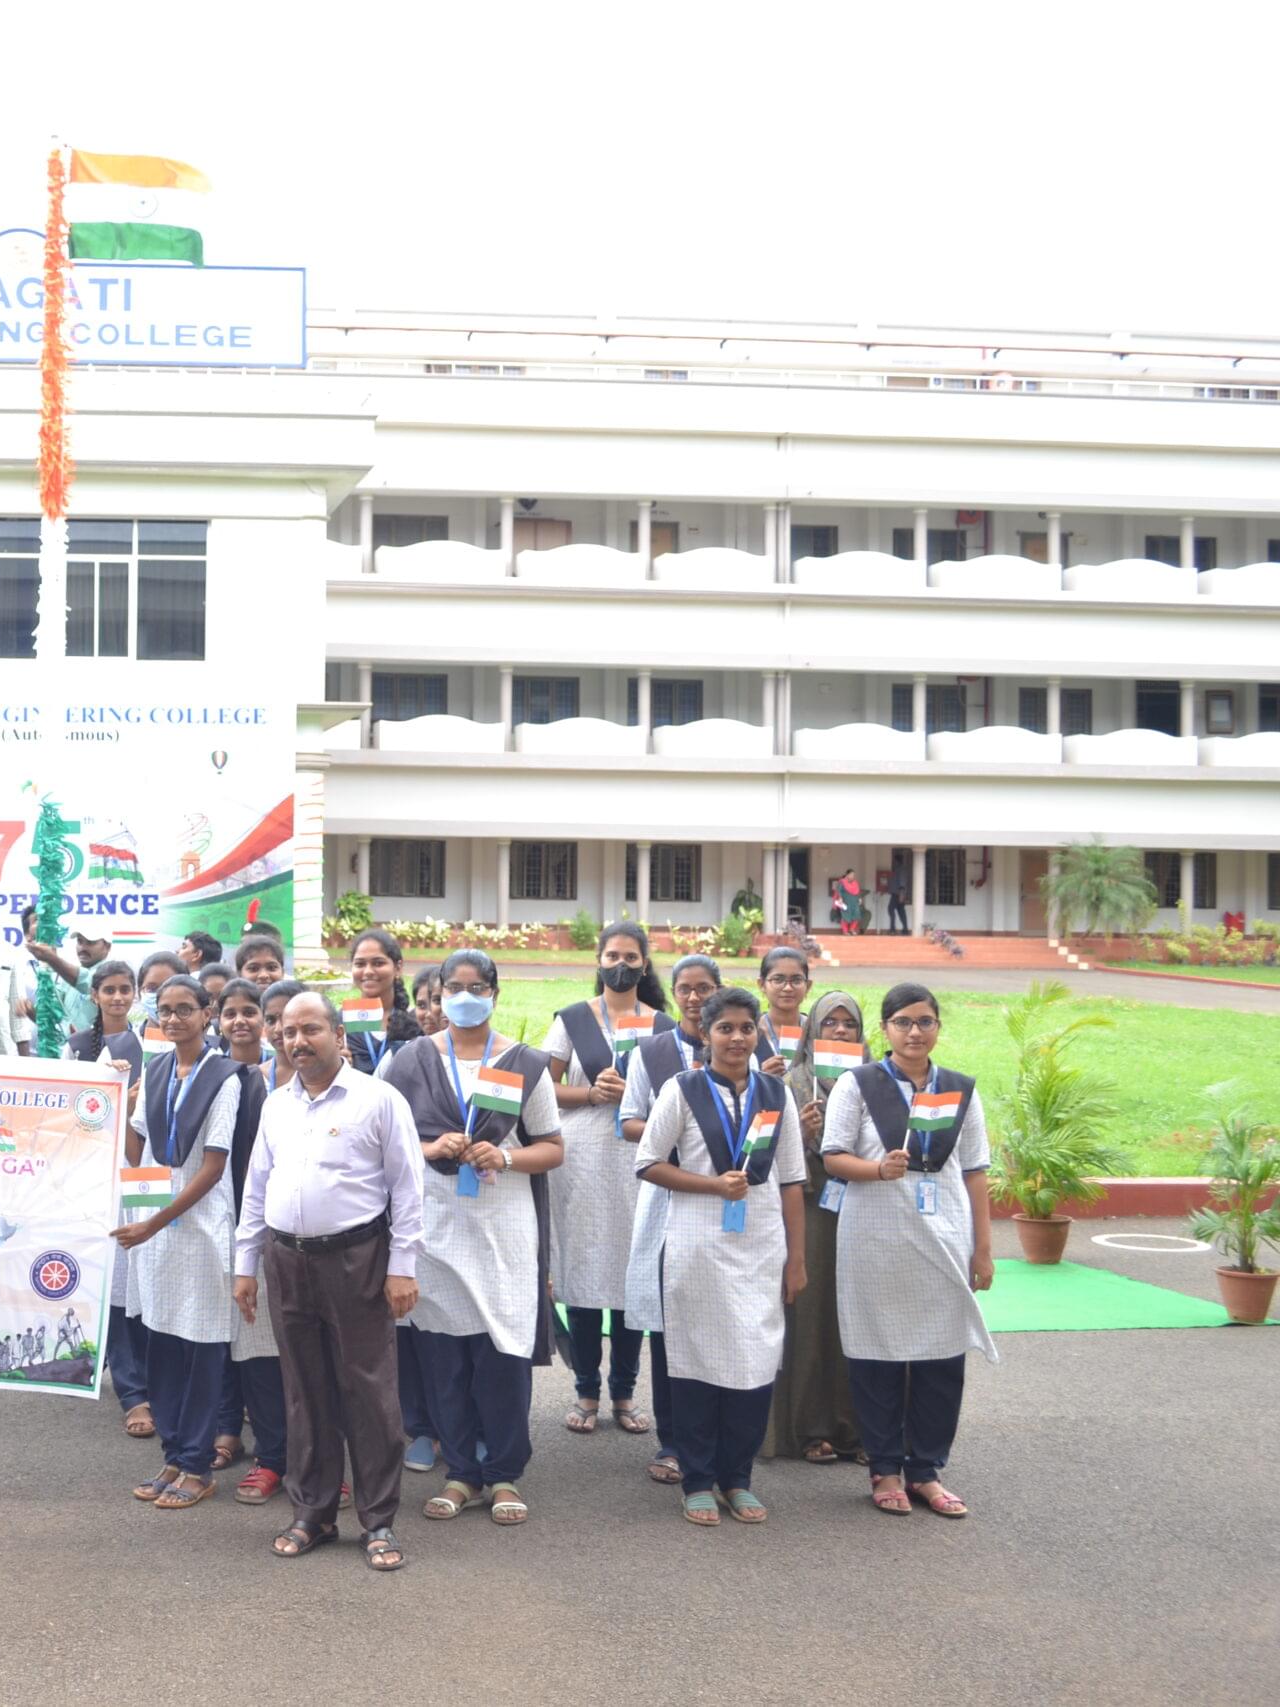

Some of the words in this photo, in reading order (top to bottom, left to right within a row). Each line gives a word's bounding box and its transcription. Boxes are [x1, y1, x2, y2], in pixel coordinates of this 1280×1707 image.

[70, 322, 252, 348] COLLEGE
[149, 707, 267, 724] COLLEGE
[1, 728, 120, 743] (Autmous)
